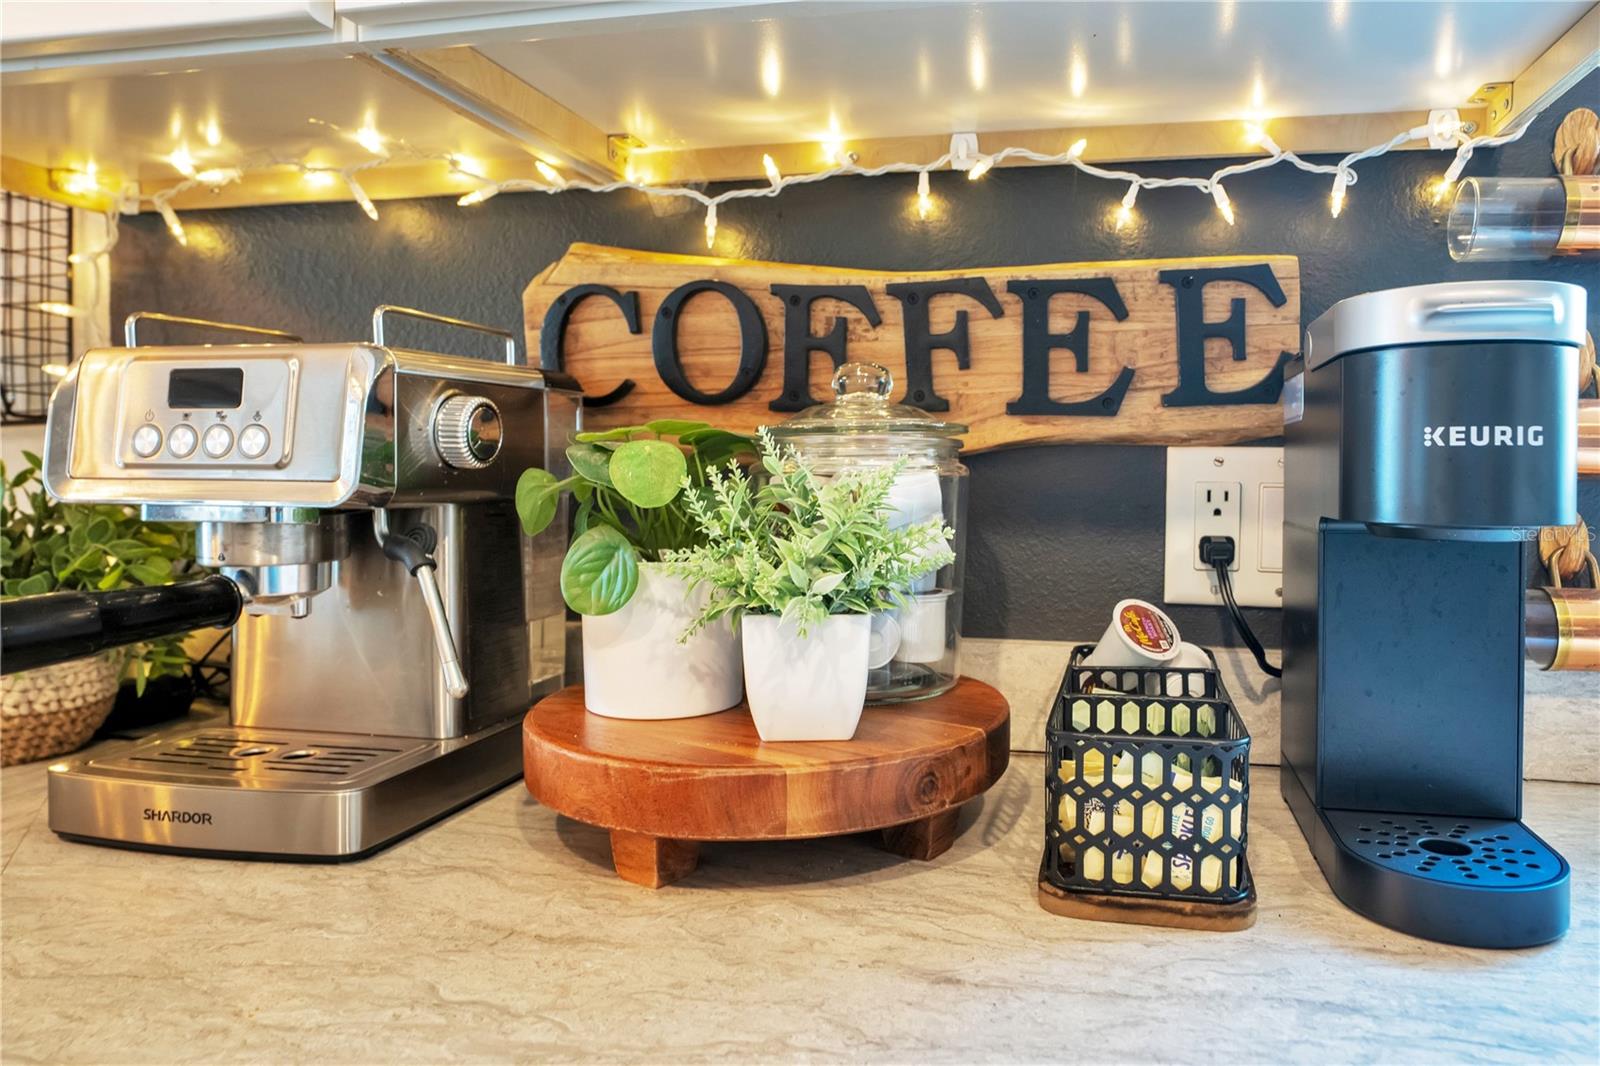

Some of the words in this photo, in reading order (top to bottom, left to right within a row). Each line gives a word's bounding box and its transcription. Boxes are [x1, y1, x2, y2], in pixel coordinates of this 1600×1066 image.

[540, 263, 1294, 417] COFFEE
[1423, 425, 1544, 447] KEURIG
[143, 808, 213, 826] SHARDOR
